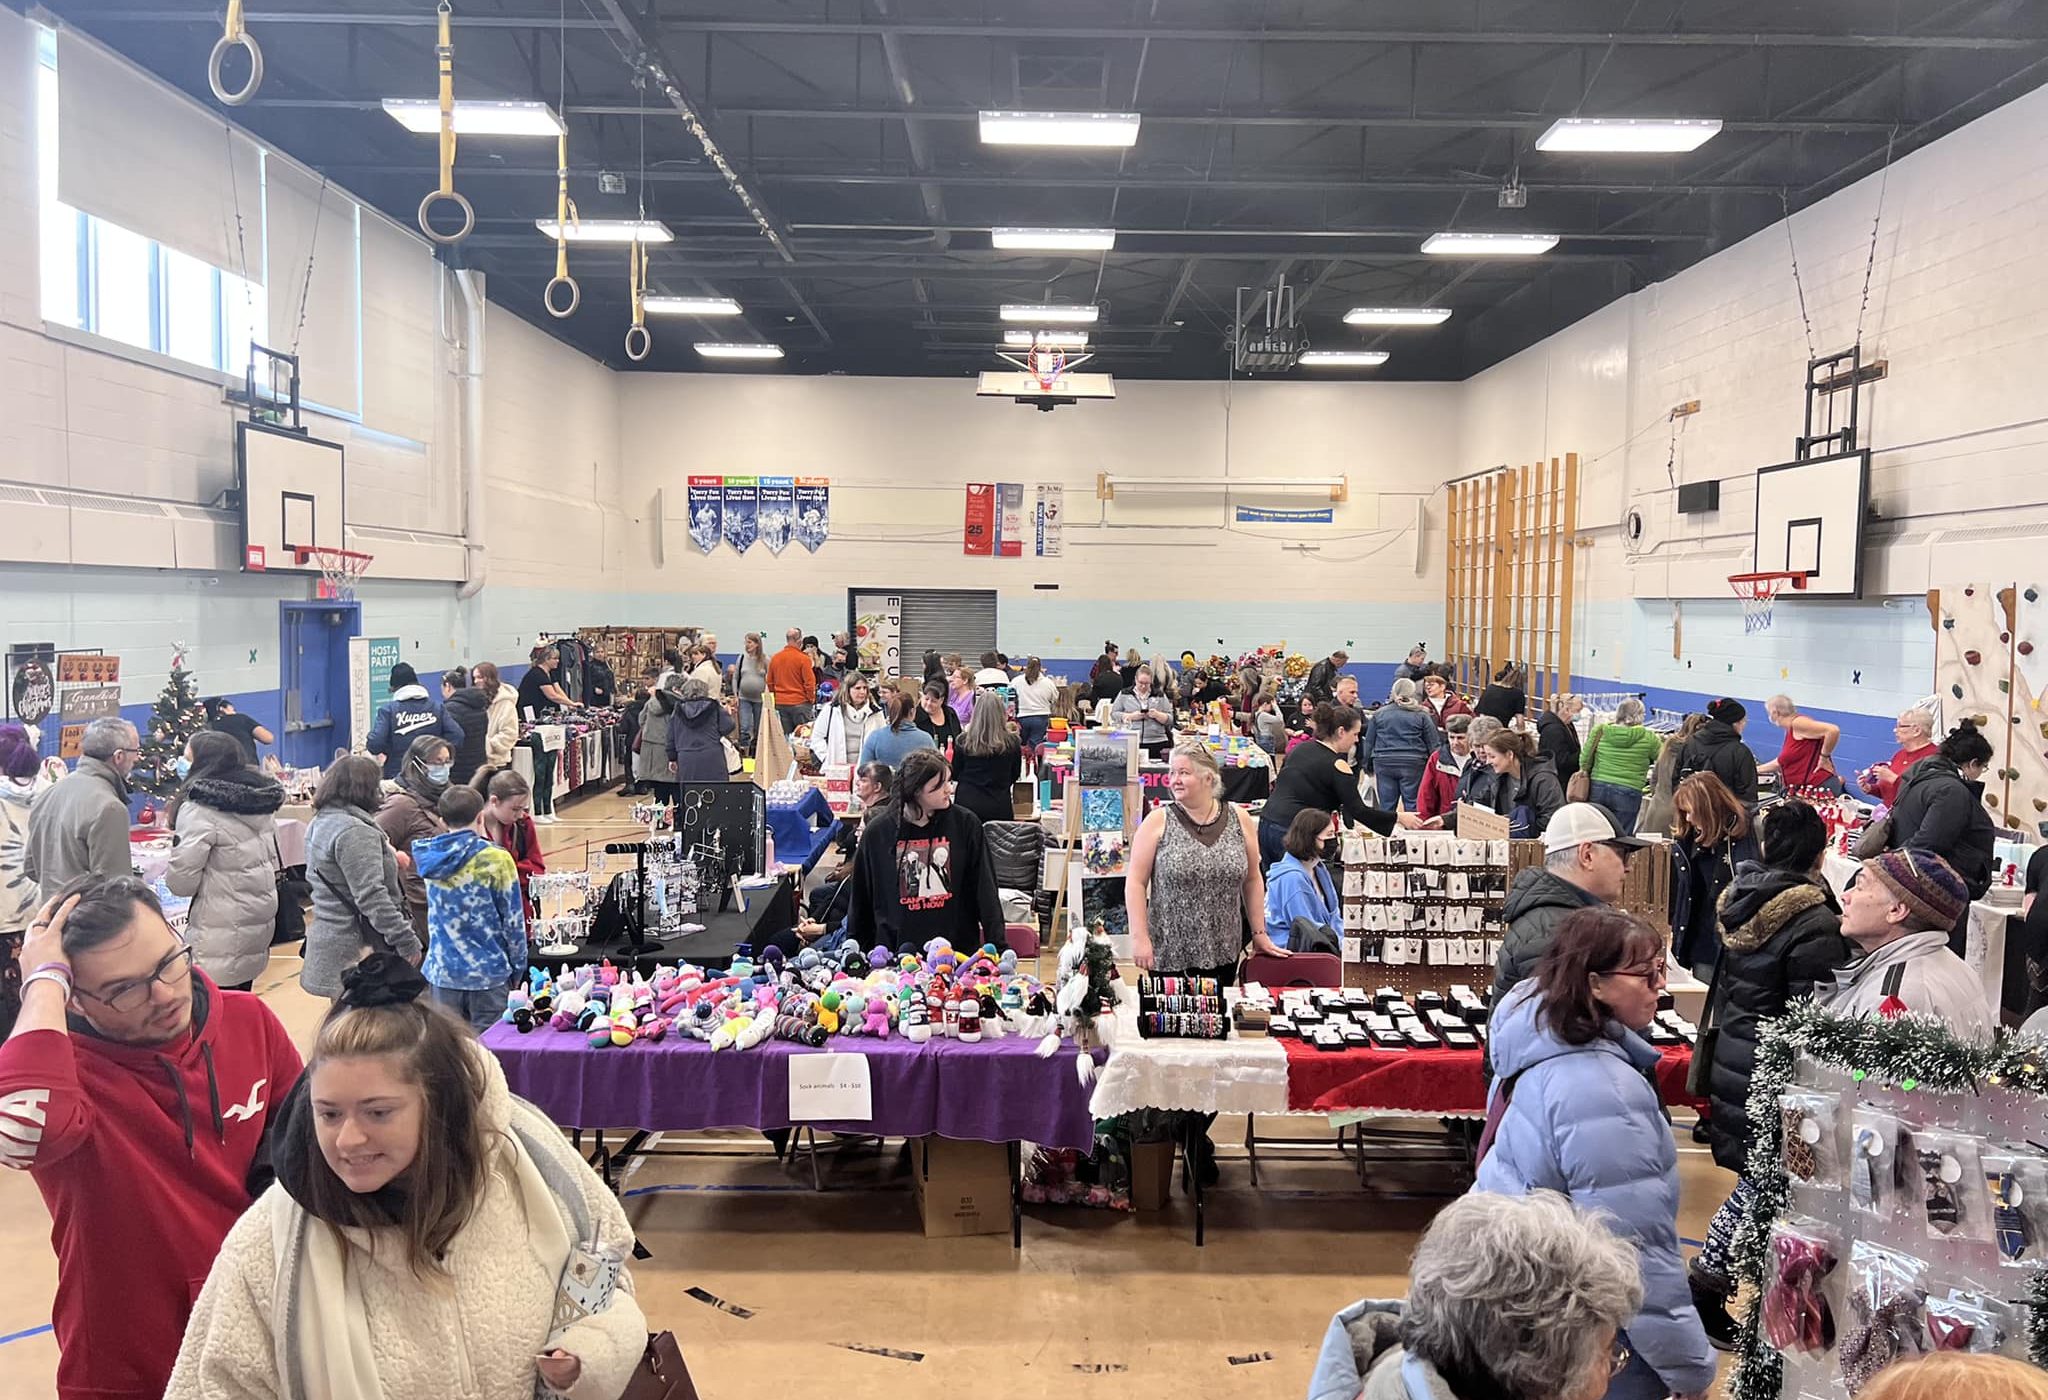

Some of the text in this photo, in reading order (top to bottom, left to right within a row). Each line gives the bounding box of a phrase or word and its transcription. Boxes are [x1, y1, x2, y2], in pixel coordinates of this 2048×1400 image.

[967, 525, 983, 535] 25
[371, 646, 398, 655] HOST A
[371, 656, 398, 667] PARTY
[923, 900, 945, 909] NOW
